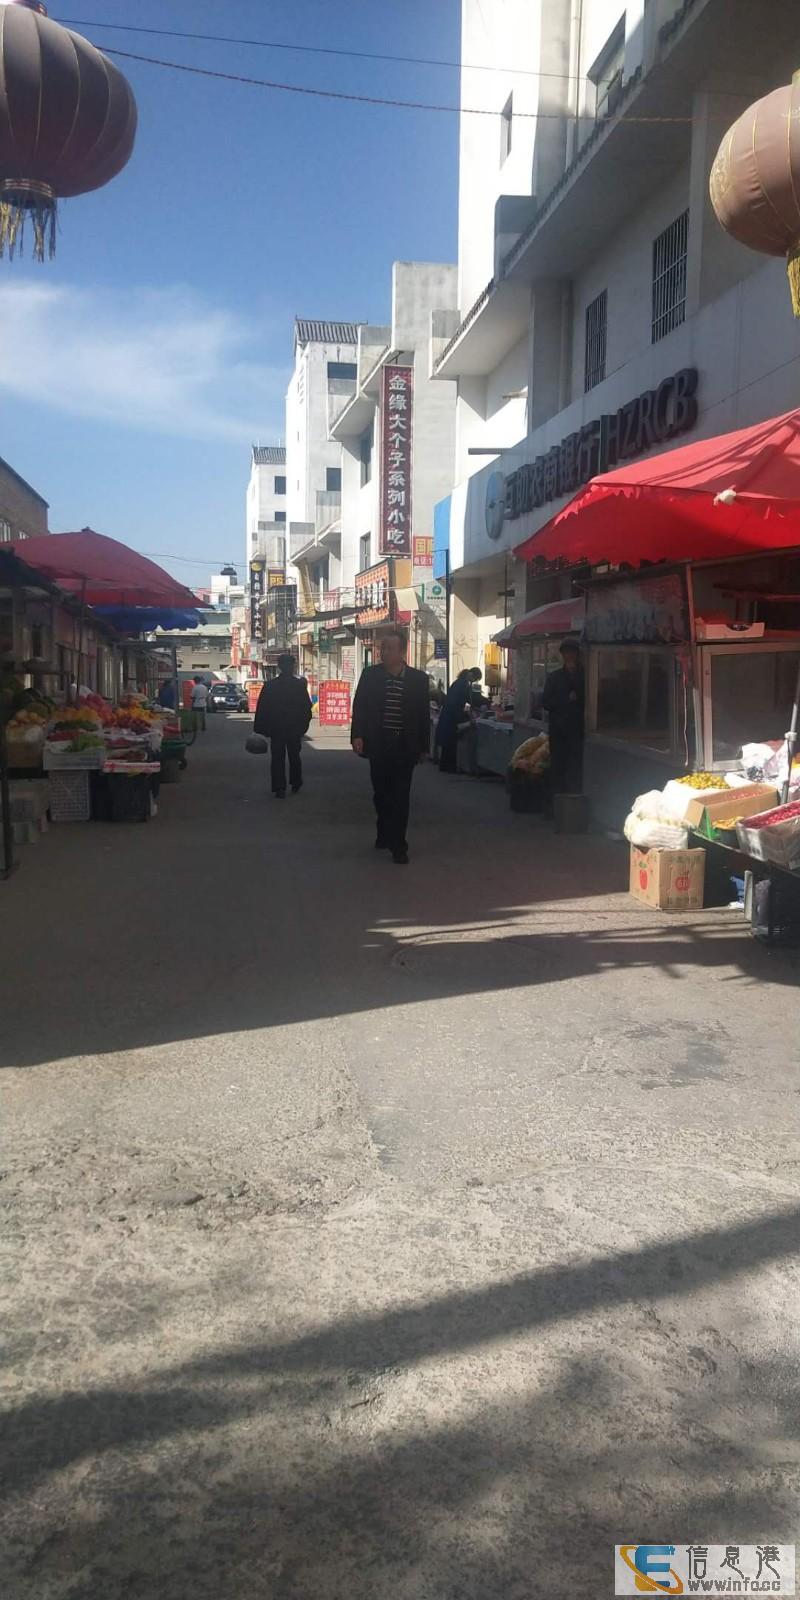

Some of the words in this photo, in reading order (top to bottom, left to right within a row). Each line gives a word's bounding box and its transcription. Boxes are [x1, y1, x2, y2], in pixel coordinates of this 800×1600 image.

[387, 374, 408, 546] 金缘大个子系列小吃
[606, 368, 699, 466] HZRCB
